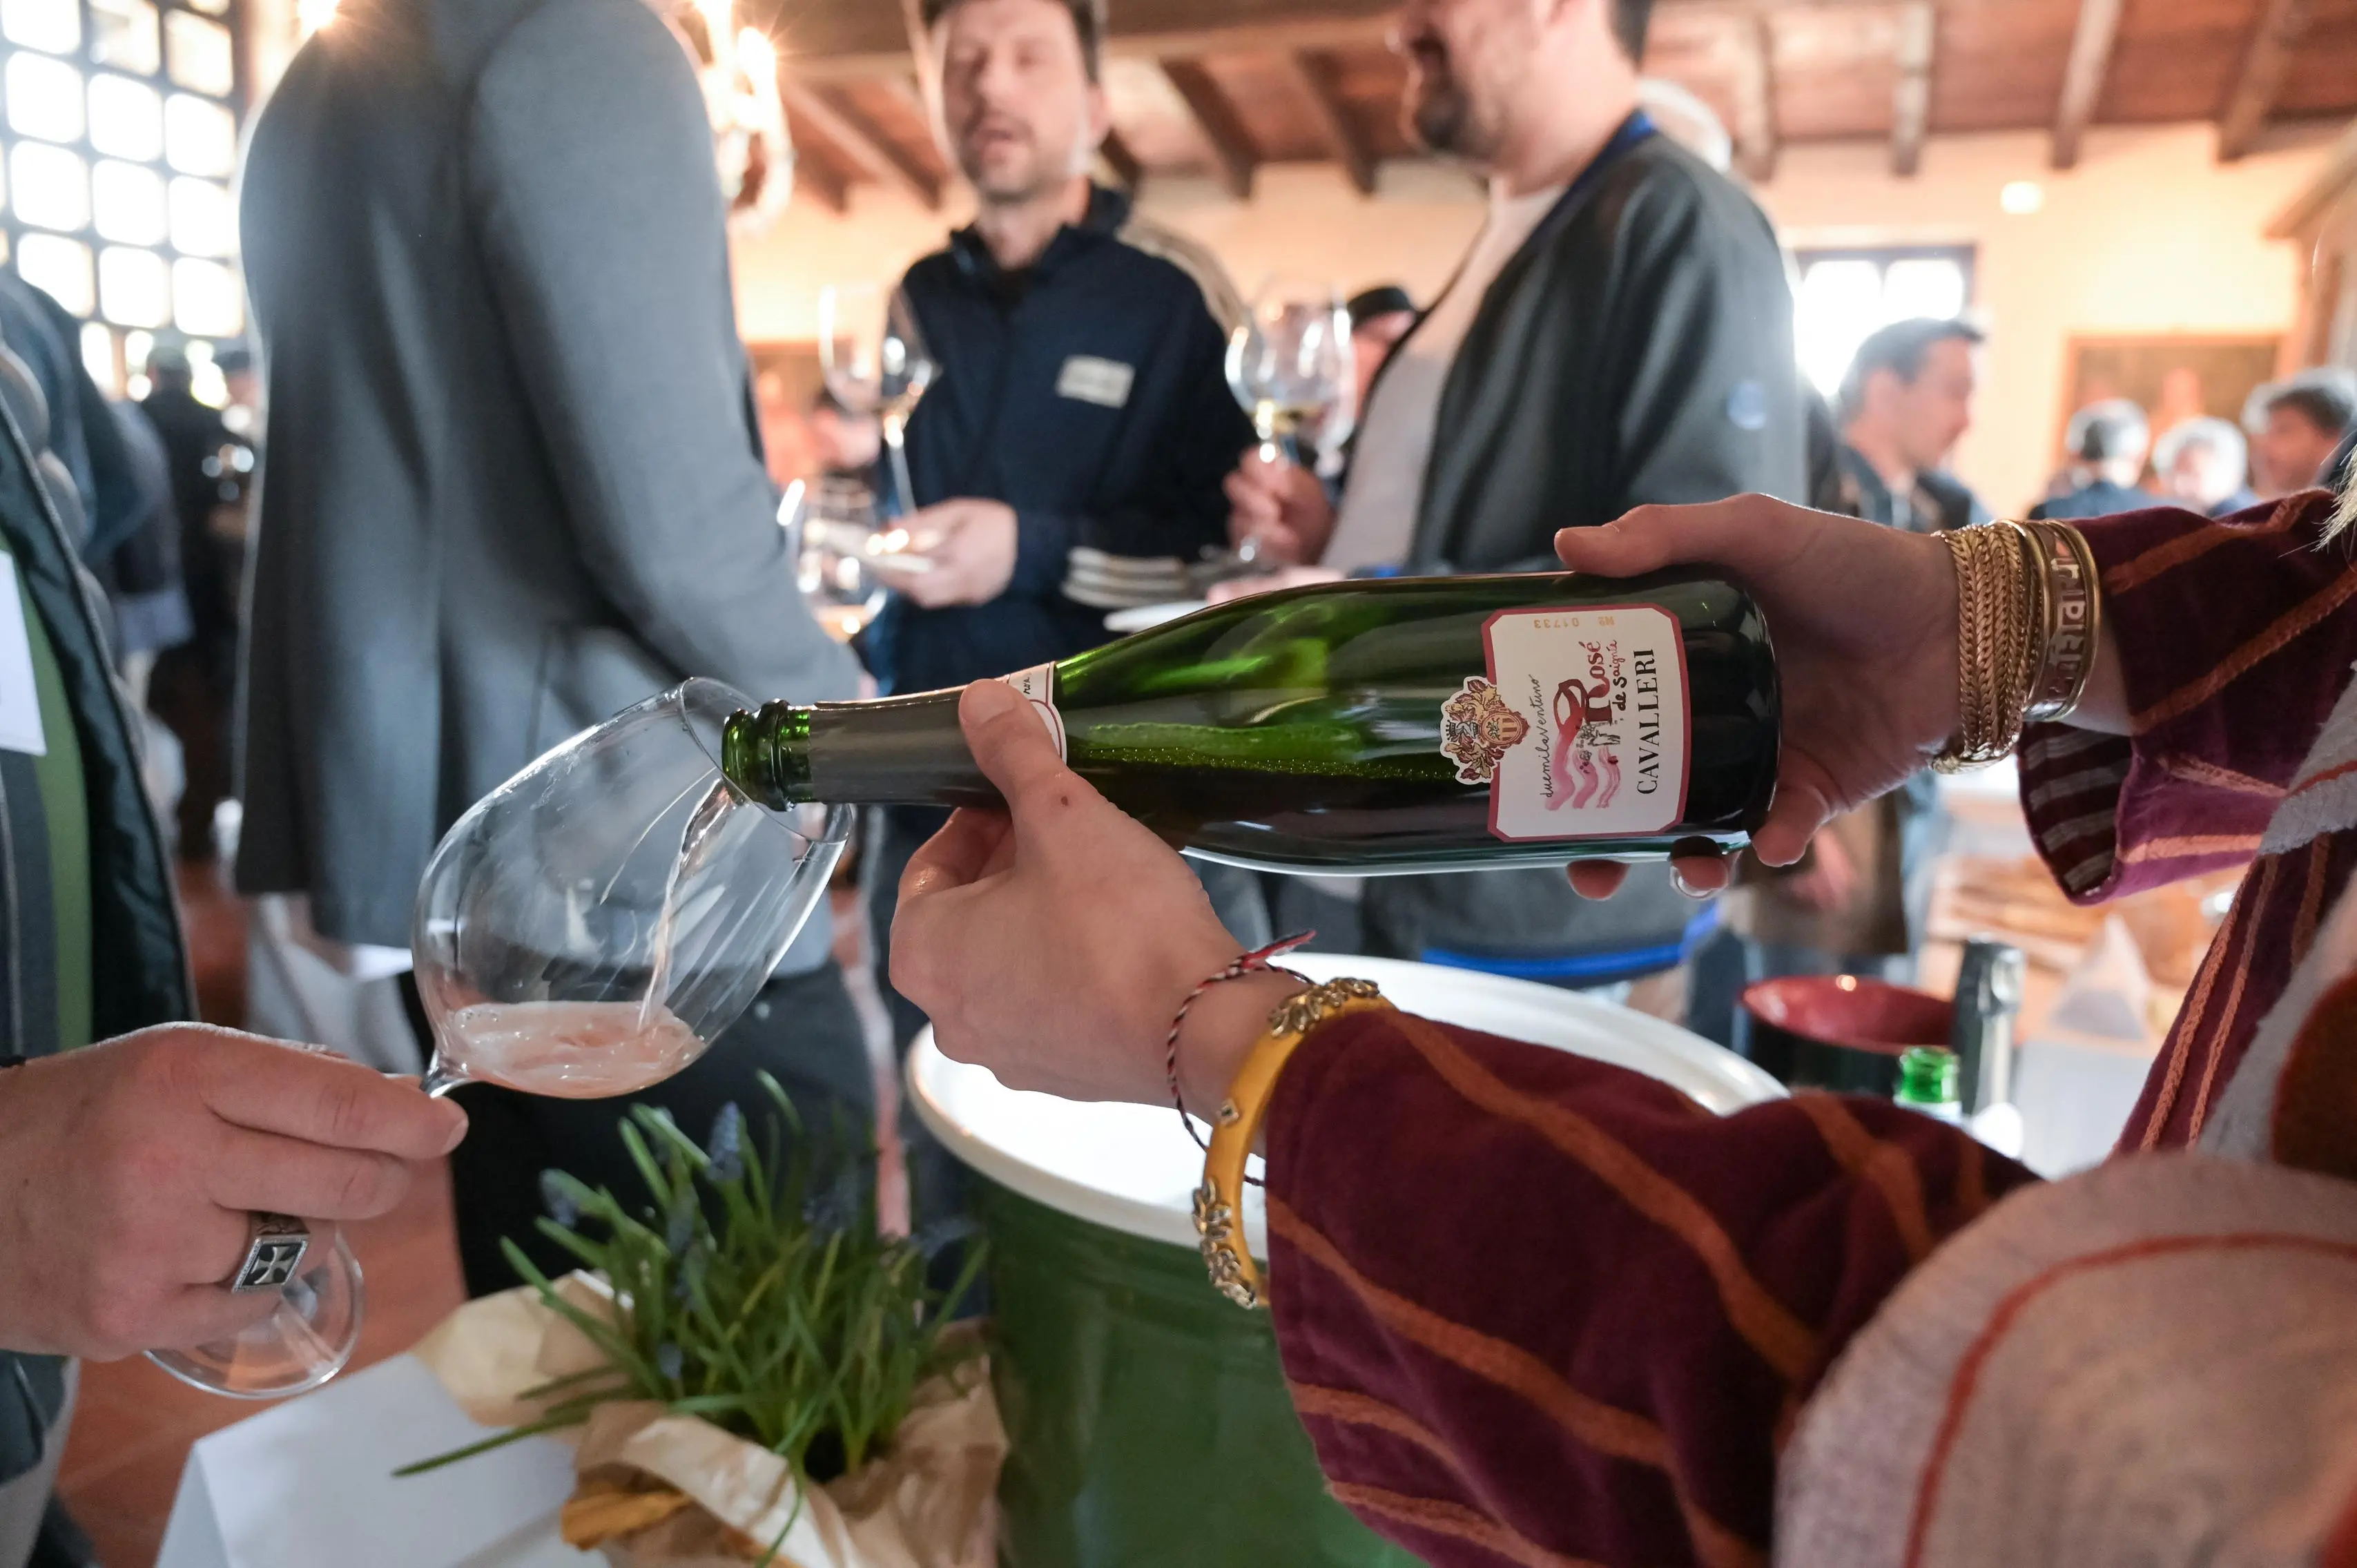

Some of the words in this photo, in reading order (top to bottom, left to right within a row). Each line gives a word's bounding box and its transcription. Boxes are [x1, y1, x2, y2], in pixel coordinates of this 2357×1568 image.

[1533, 617, 1580, 629] 01733
[1553, 639, 1613, 727] Rosé
[1611, 692, 1627, 712] de
[1633, 648, 1660, 795] CAVALLERI
